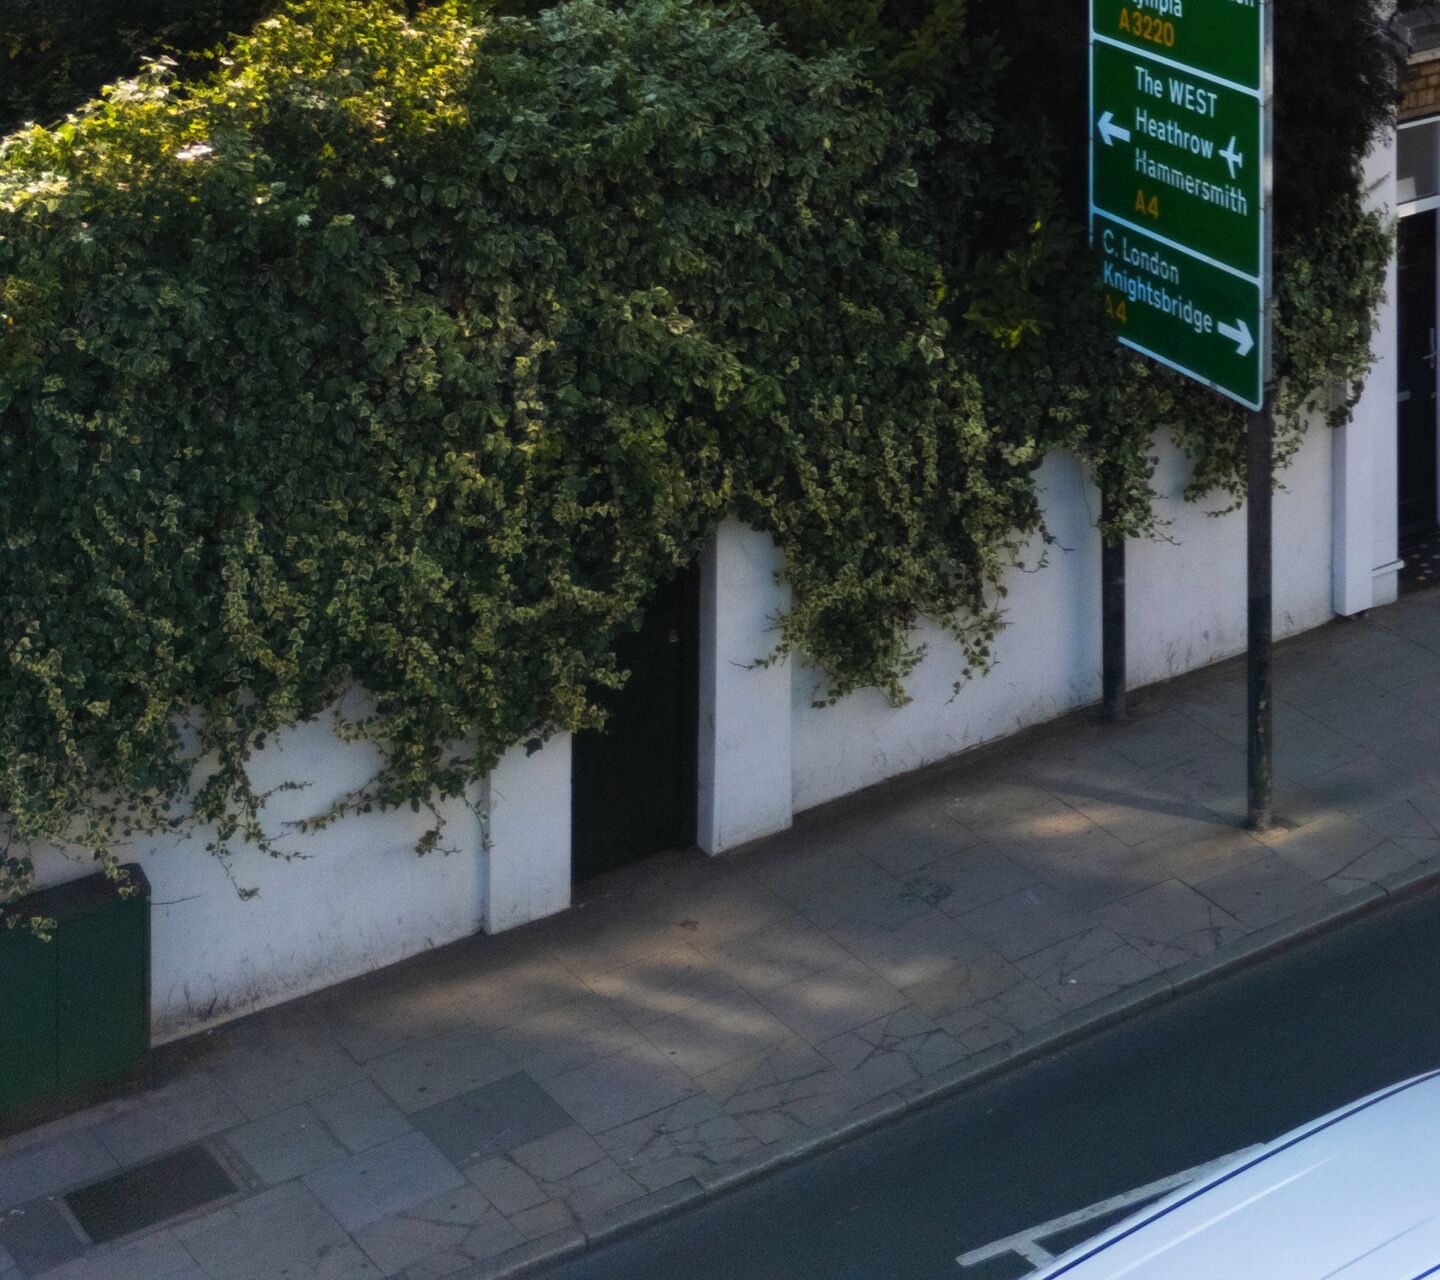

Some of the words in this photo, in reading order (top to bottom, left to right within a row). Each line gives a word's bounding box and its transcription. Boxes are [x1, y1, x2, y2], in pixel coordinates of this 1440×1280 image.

[1119, 7, 1175, 47] A3220
[1135, 66, 1163, 98] The
[1168, 77, 1218, 118] WEST
[1136, 106, 1214, 159] Heathrow
[1135, 147, 1248, 216] Hammersmith
[1135, 190, 1159, 219] A4
[1103, 228, 1119, 258] C.
[1122, 236, 1180, 285] London
[1103, 260, 1213, 334] Knightsbridge
[1105, 294, 1127, 324] A4
